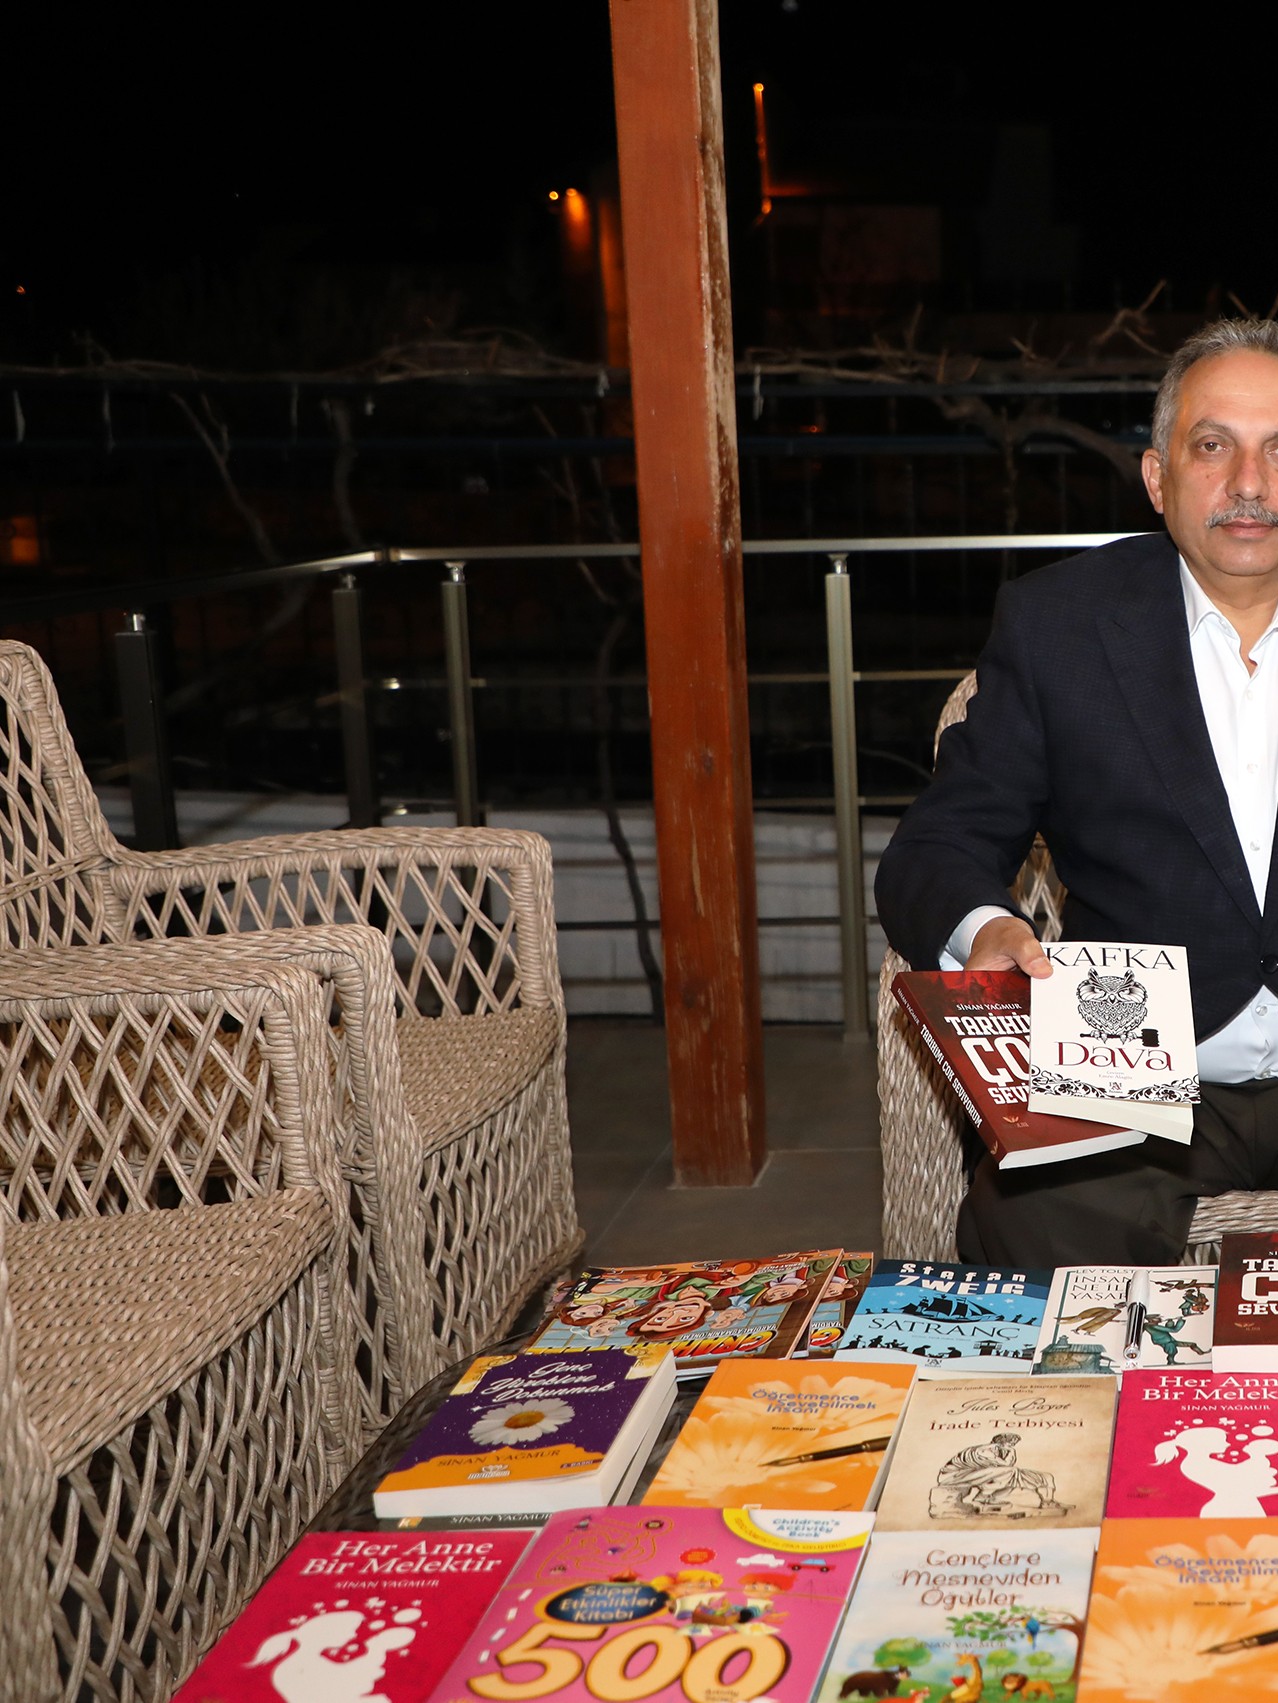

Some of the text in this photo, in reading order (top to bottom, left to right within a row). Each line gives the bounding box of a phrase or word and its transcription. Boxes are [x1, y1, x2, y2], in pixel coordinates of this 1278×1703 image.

[1044, 946, 1178, 970] KAFKA
[956, 1003, 1022, 1011] SİNAN YAĞMUR
[960, 1036, 1030, 1088] ÇO
[1054, 1040, 1176, 1072] Dava
[988, 1082, 1030, 1104] SEVİ
[952, 1078, 984, 1128] SEVİYORUM
[894, 1274, 1026, 1296] ZWEIG
[1072, 1283, 1124, 1292] NE İL
[868, 1317, 1022, 1341] SATRANÇ
[640, 1330, 778, 1360] GRAH
[528, 1362, 592, 1378] Gene
[1158, 1376, 1212, 1388] Her
[492, 1382, 616, 1402] Dokunmak
[752, 1388, 860, 1402] Öğretmence
[1142, 1388, 1185, 1401] Bir
[776, 1398, 878, 1410] Sevebilmek
[946, 1397, 1000, 1416] Jules
[930, 1418, 1085, 1432] İrade Terbiyesi
[437, 1450, 560, 1467] SİNAN YAĞMUR
[450, 1514, 494, 1525] SİNAN
[772, 1517, 841, 1526] Children's
[776, 1524, 834, 1534] Activity
[330, 1540, 494, 1558] Her Anne
[300, 1556, 502, 1576] Bir Melektir
[926, 1548, 1041, 1569] Gençlere
[334, 1578, 440, 1590] SİNAN YAĞMUR
[900, 1568, 1061, 1588] Mesneviden
[583, 1584, 642, 1600] Süper
[559, 1595, 659, 1612] Etkinlikler
[573, 1609, 634, 1624] Kitabı
[466, 1624, 792, 1702] 500
